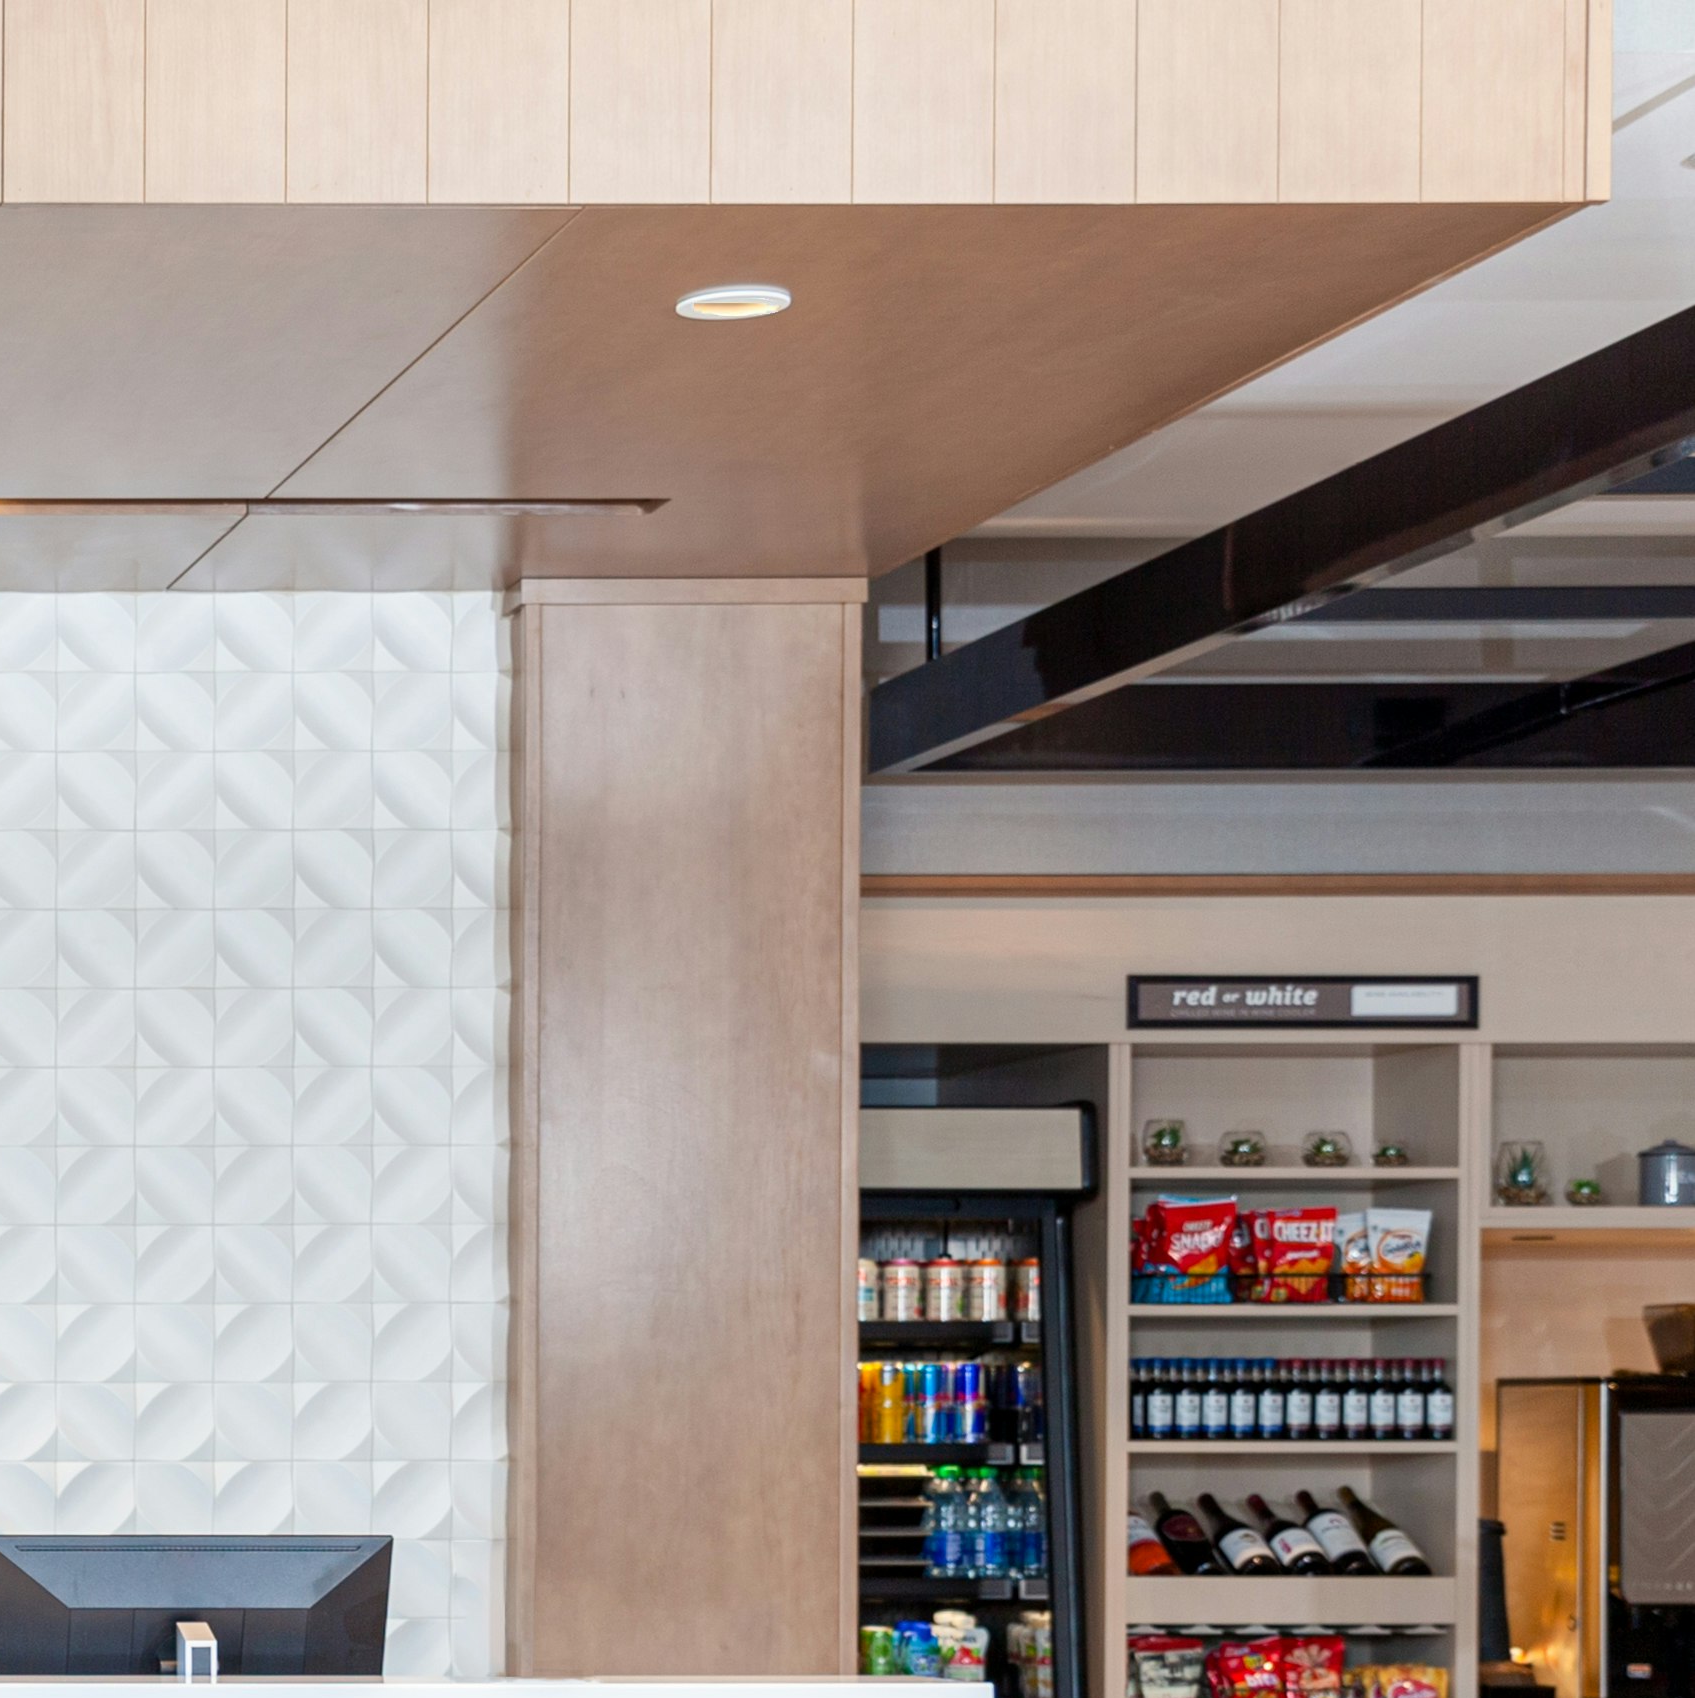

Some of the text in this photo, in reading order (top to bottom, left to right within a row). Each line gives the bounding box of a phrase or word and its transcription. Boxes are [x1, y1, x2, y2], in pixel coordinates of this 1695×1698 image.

[1172, 984, 1318, 1006] red or white
